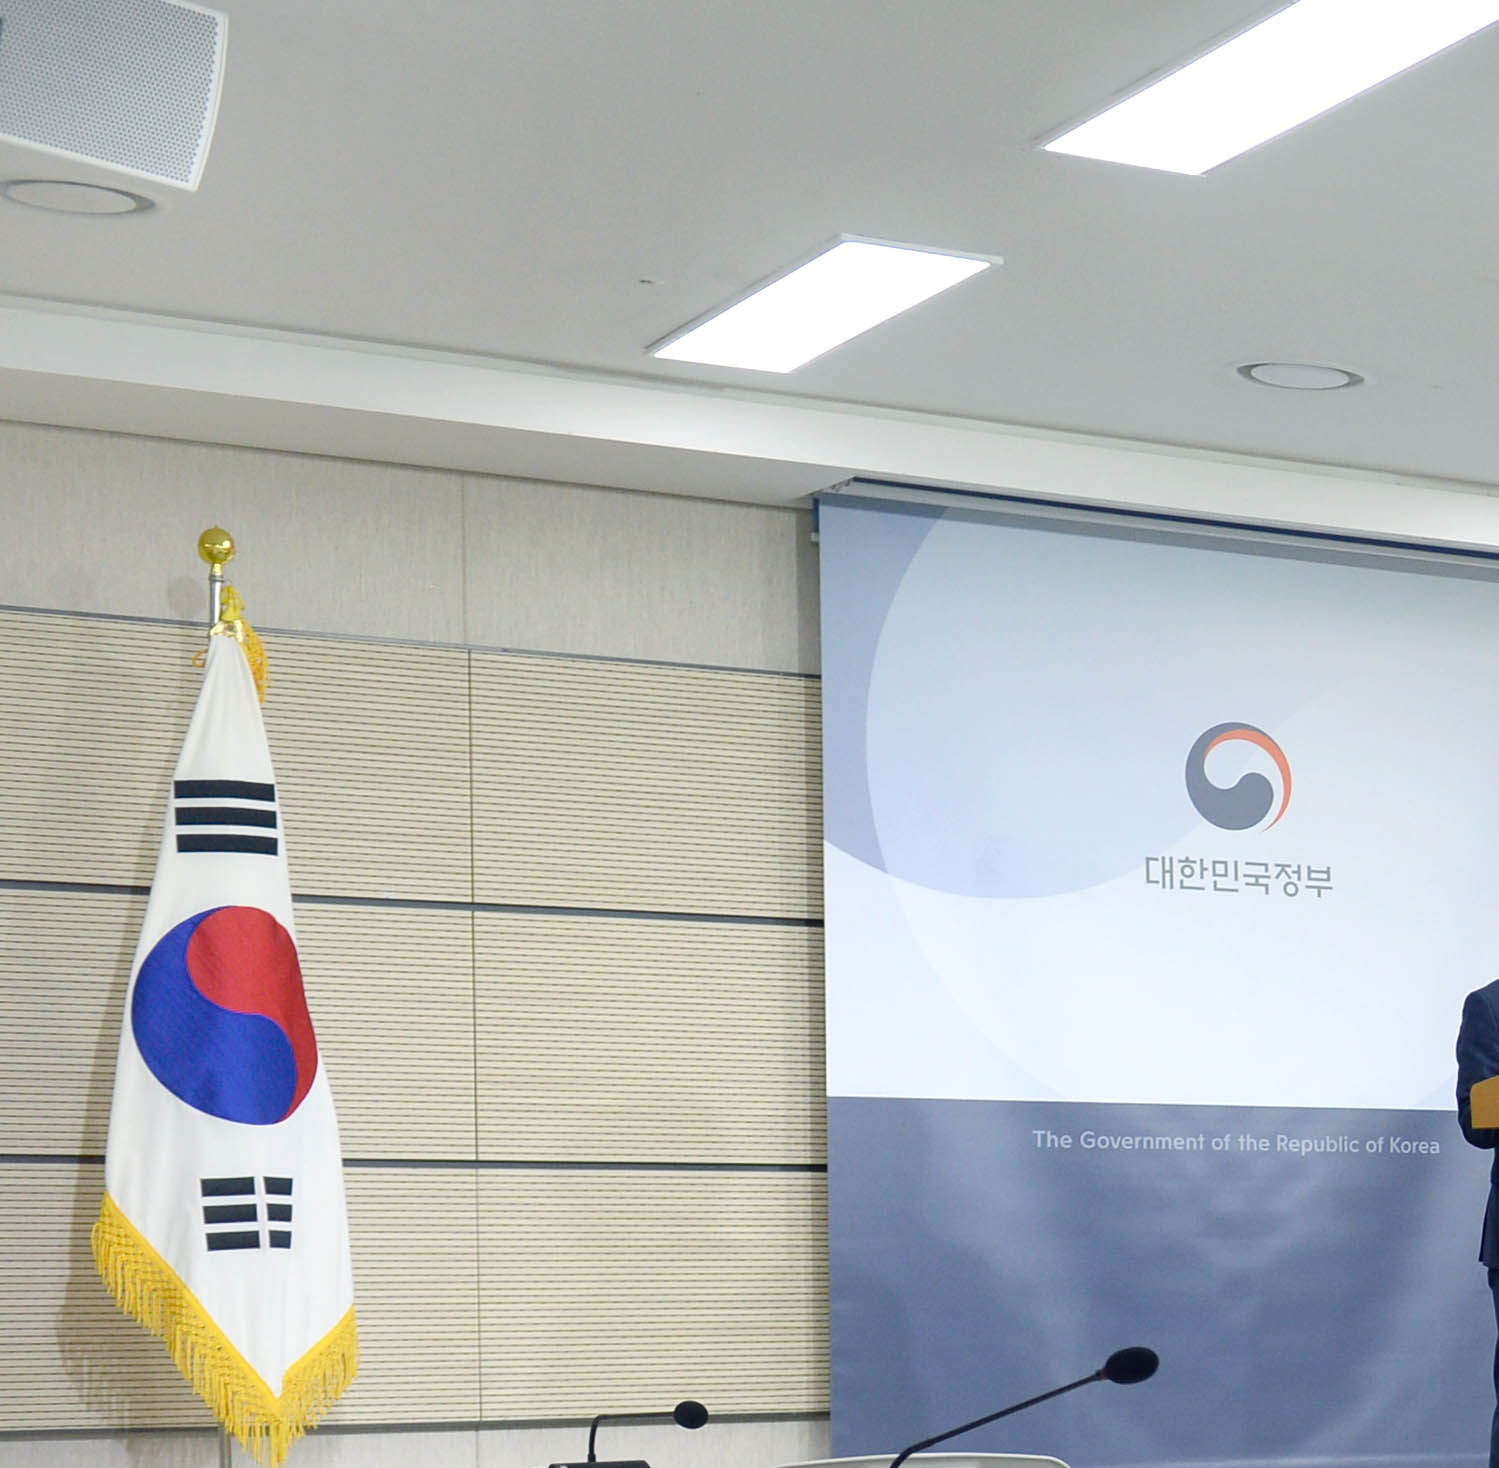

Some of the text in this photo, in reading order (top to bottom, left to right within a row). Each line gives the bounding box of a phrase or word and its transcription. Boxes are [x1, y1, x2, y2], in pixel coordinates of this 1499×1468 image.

[1145, 856, 1334, 897] 대한민국정부
[1033, 1130, 1440, 1156] The Government of the Republic of Korea
